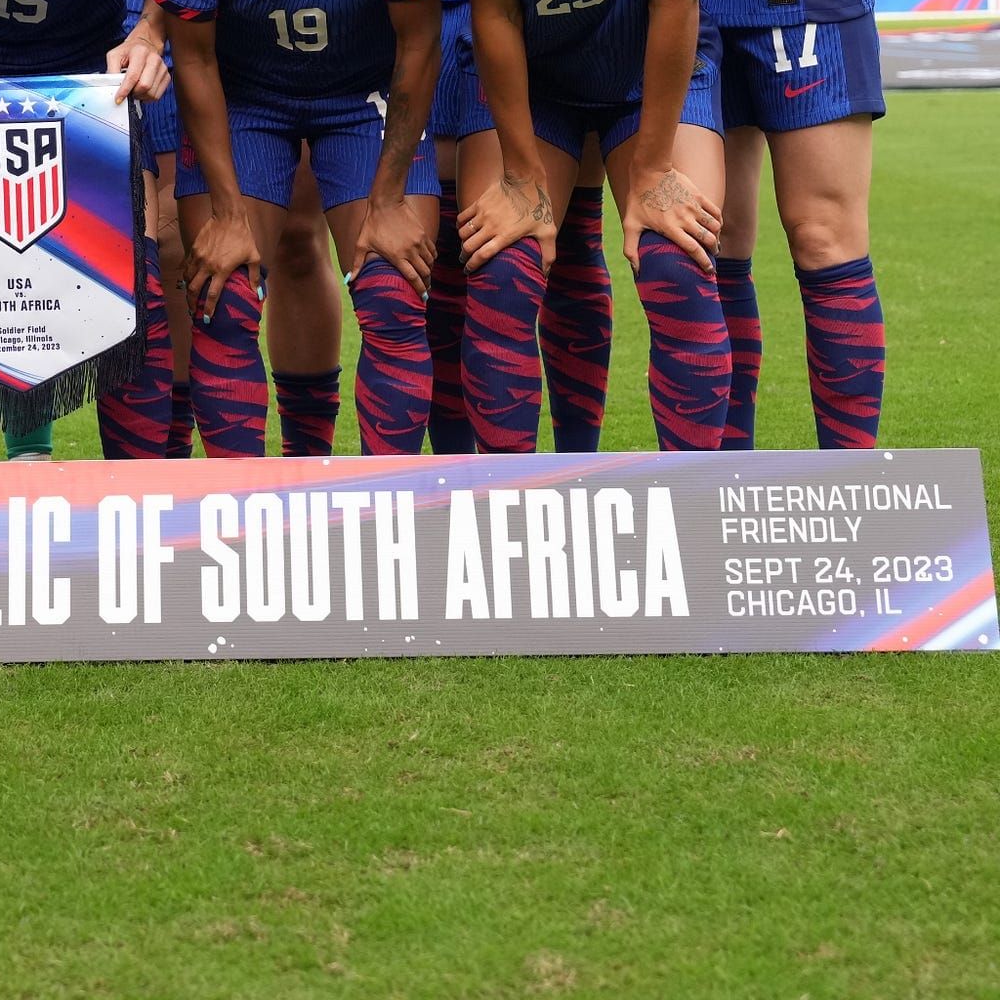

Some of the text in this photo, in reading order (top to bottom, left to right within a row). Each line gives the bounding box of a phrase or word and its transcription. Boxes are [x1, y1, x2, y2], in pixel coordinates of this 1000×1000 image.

[268, 8, 329, 52] 19
[7, 277, 33, 290] USA
[20, 299, 61, 312] AFRICA
[25, 334, 53, 343] Illinois
[27, 325, 46, 334] Field
[27, 343, 40, 352] 24,
[41, 342, 61, 351] 2023
[719, 484, 953, 512] INTERNATIONAL
[721, 516, 862, 544] FRIENDLY
[98, 494, 175, 624] OF
[200, 490, 419, 623] SOUTH
[445, 486, 690, 620] AFRICA
[725, 555, 954, 585] SEPT 24, 2023
[727, 588, 902, 617] CHICAGO, IL
